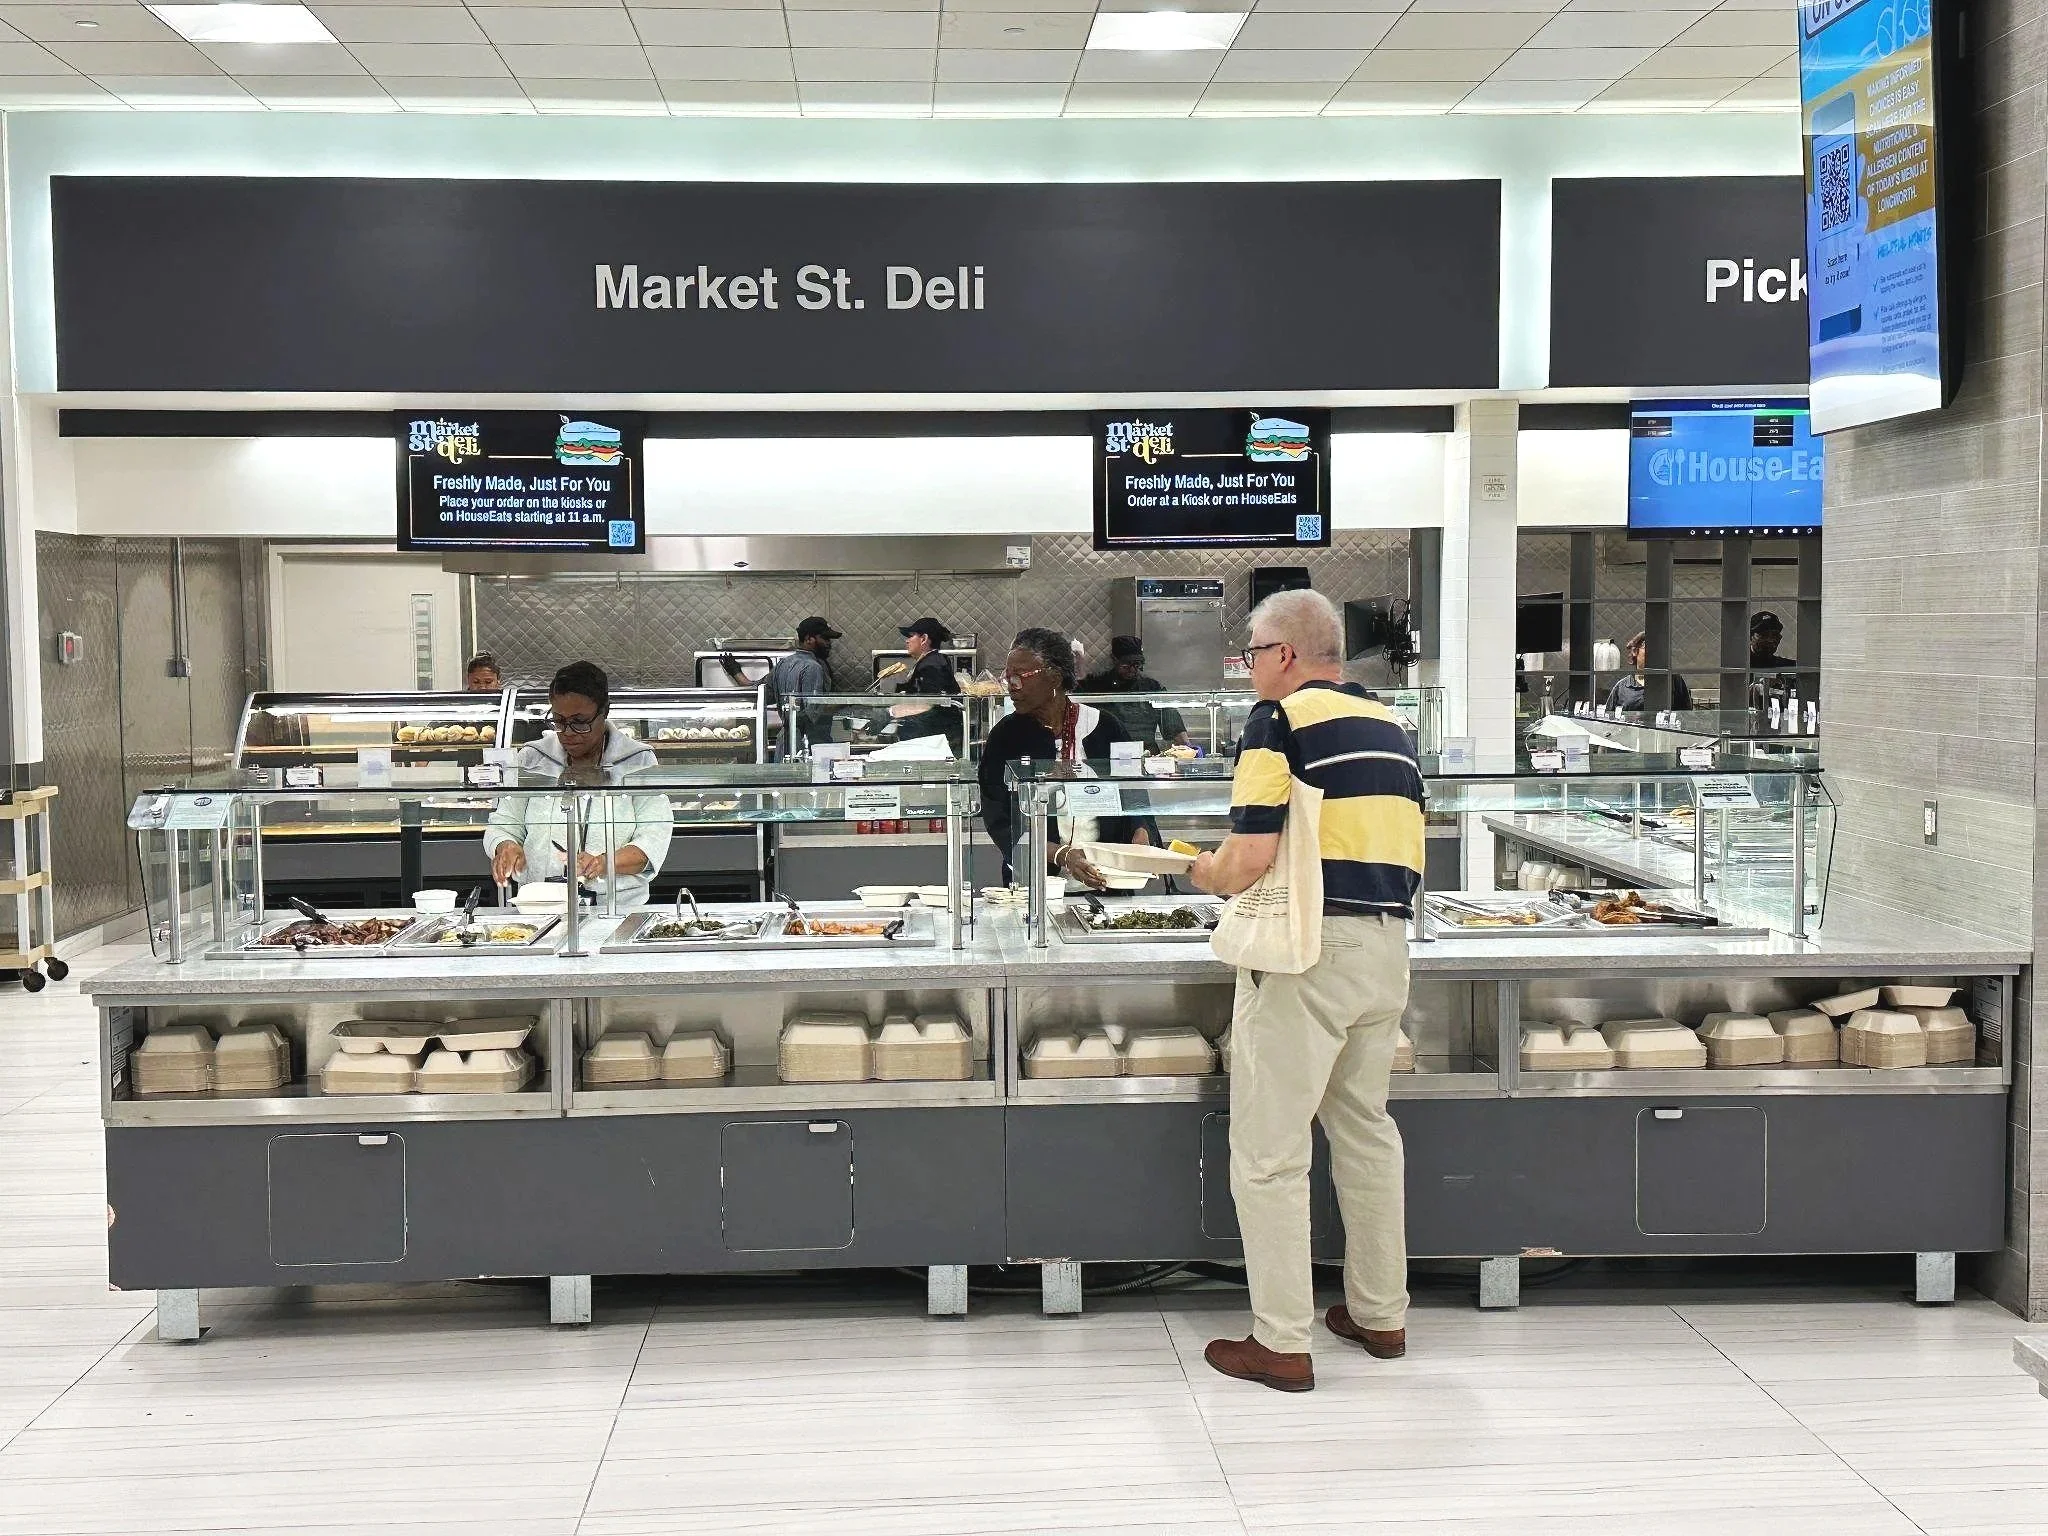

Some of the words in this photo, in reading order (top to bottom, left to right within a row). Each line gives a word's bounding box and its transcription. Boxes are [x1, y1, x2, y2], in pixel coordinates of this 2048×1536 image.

[1889, 57, 1922, 85] INFORMED
[1869, 93, 1895, 117] CHOICES
[1902, 80, 1919, 99] EASY
[1899, 104, 1912, 121] FOR
[1913, 97, 1926, 115] THE
[1873, 125, 1912, 155] NUTRITIONAL
[1866, 153, 1898, 178] ALLERGEN
[1898, 139, 1927, 164] CONTENT
[1875, 171, 1900, 194] TODAY'S
[1900, 163, 1919, 183] MENU
[1919, 160, 1928, 176] AT
[595, 264, 779, 310] Market
[796, 264, 865, 311] St.
[886, 265, 985, 311] Deli
[1706, 258, 1808, 303] Pick
[1688, 451, 1783, 482] House
[433, 474, 482, 493] Freshly
[485, 475, 526, 492] Made,
[529, 476, 557, 491] Just
[560, 476, 583, 491] For
[586, 476, 611, 492] You
[1125, 474, 1171, 491] Freshly
[1174, 474, 1213, 490] Made,
[1217, 473, 1243, 488] Just
[1247, 473, 1269, 487] For
[1271, 473, 1295, 487] You
[439, 495, 469, 507] Place
[471, 497, 495, 509] your
[496, 496, 525, 508] order
[526, 499, 540, 508] on
[541, 496, 558, 508] the
[560, 496, 593, 509] kiosks
[595, 498, 607, 508] or
[1127, 494, 1158, 506] Order
[1159, 495, 1170, 506] at
[1171, 497, 1179, 506] a
[1181, 493, 1210, 505] Kiosk
[1212, 495, 1223, 505] or
[1225, 495, 1239, 505] on
[1241, 492, 1297, 504] HouseEats
[439, 511, 453, 522] on
[456, 509, 512, 522] HouseEats
[514, 511, 553, 525] starting
[555, 512, 565, 522] at
[568, 511, 580, 522] 11
[582, 512, 605, 523] a.m.
